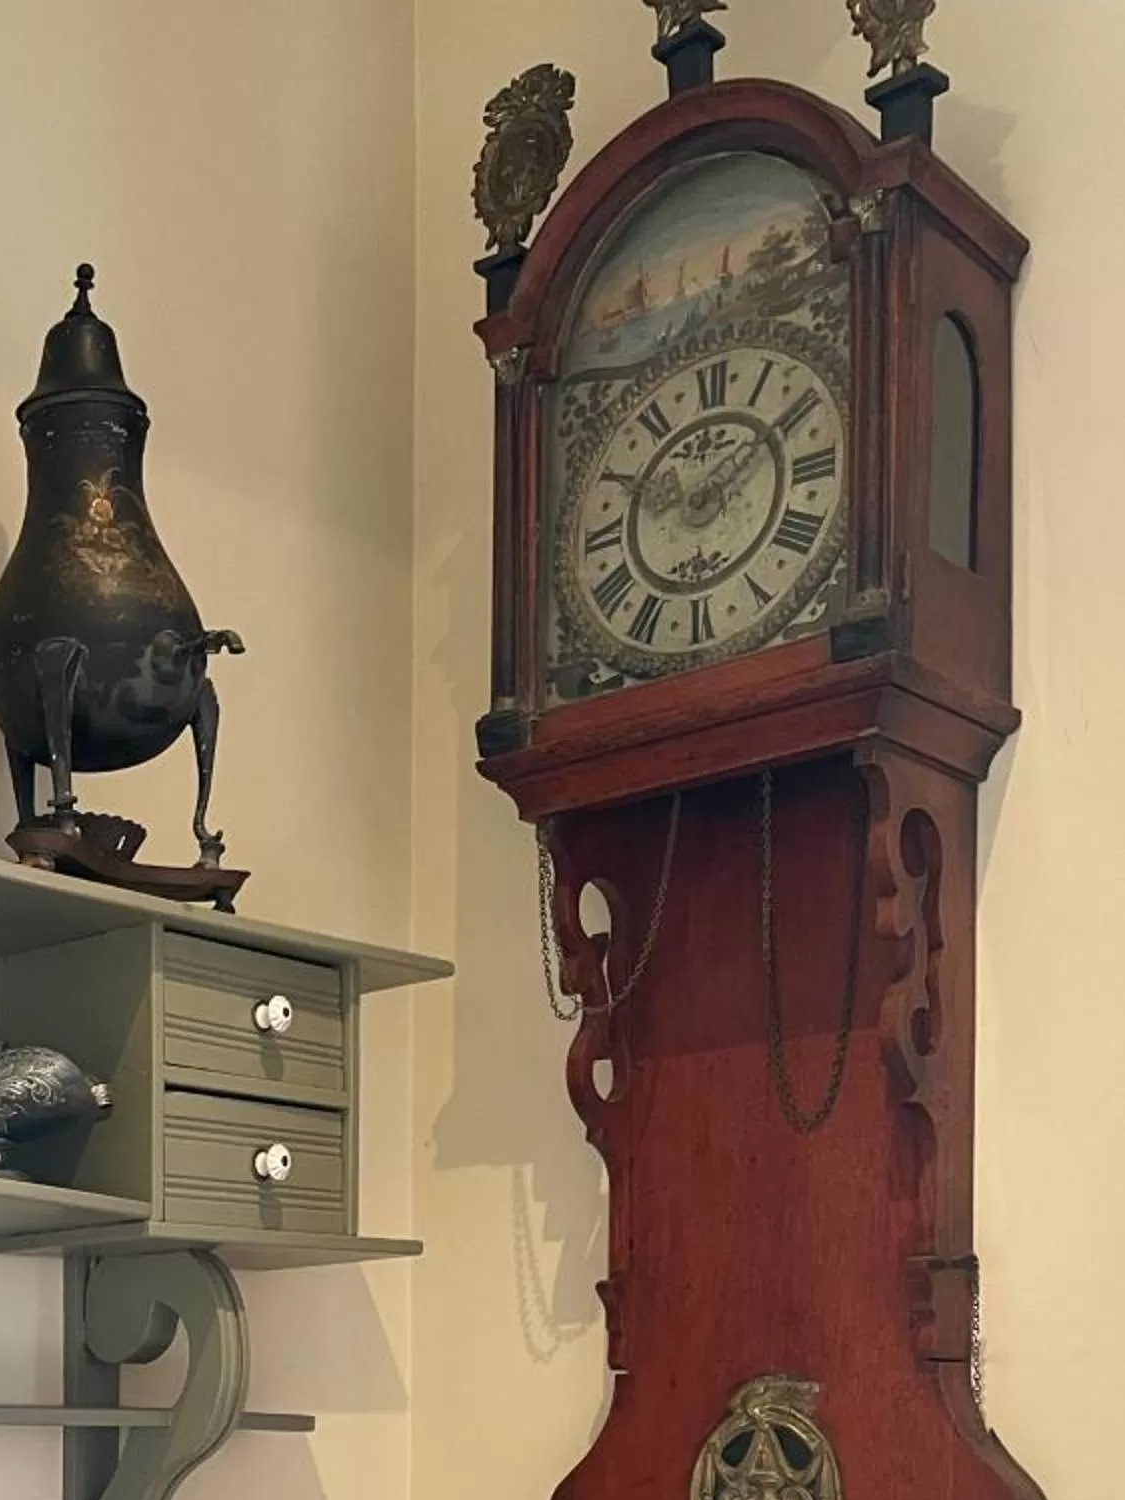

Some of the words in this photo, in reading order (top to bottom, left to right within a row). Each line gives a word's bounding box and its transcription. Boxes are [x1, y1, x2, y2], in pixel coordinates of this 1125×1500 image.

[747, 357, 779, 407] I
[790, 441, 837, 488] III
[770, 503, 828, 556] IIII
